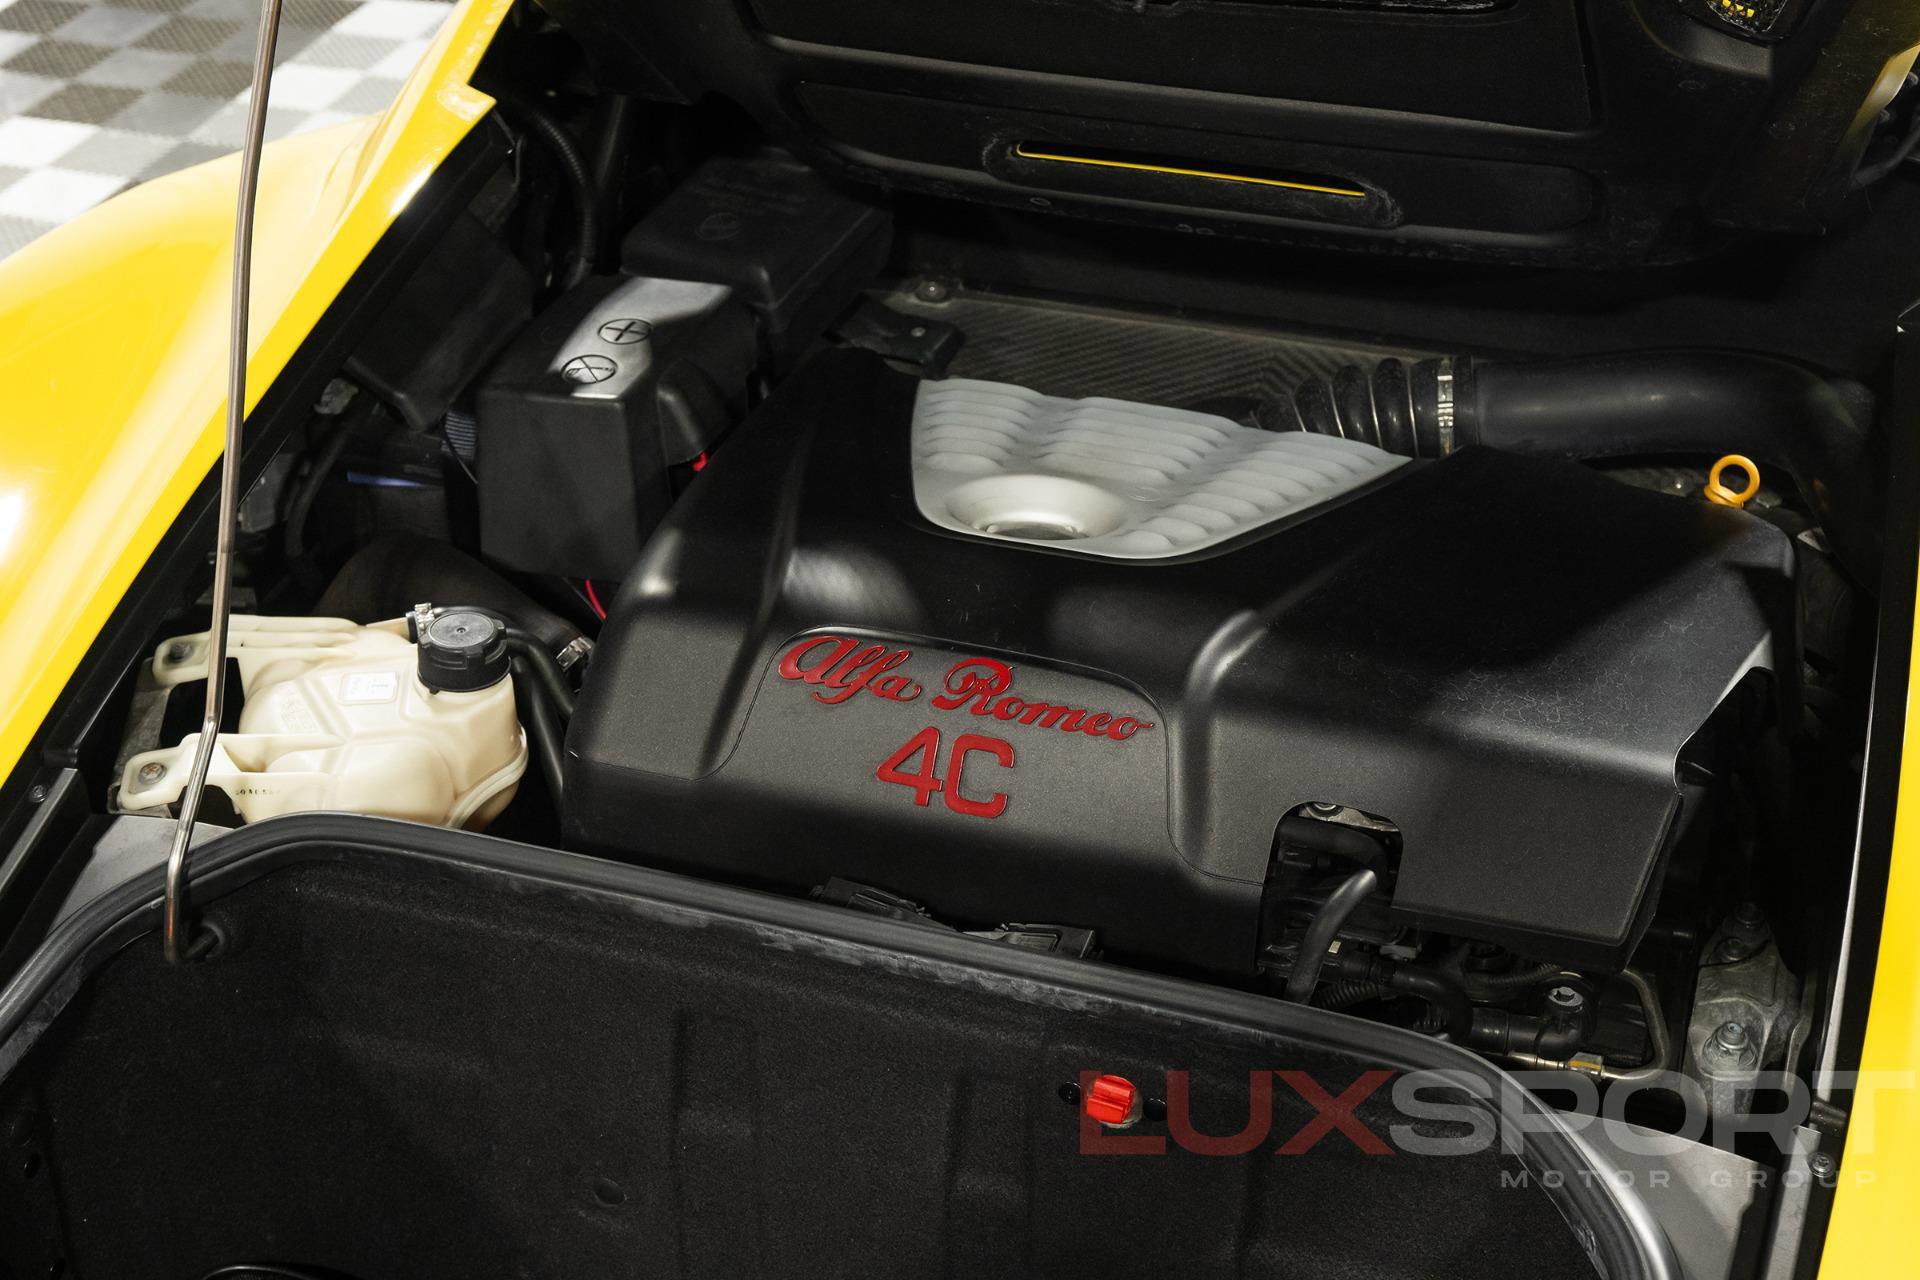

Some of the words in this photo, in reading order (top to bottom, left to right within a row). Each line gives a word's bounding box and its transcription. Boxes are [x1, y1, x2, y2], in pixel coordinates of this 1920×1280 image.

[778, 635, 921, 704] Alfa
[932, 657, 1154, 740] Romeo
[876, 726, 1015, 820] 4C
